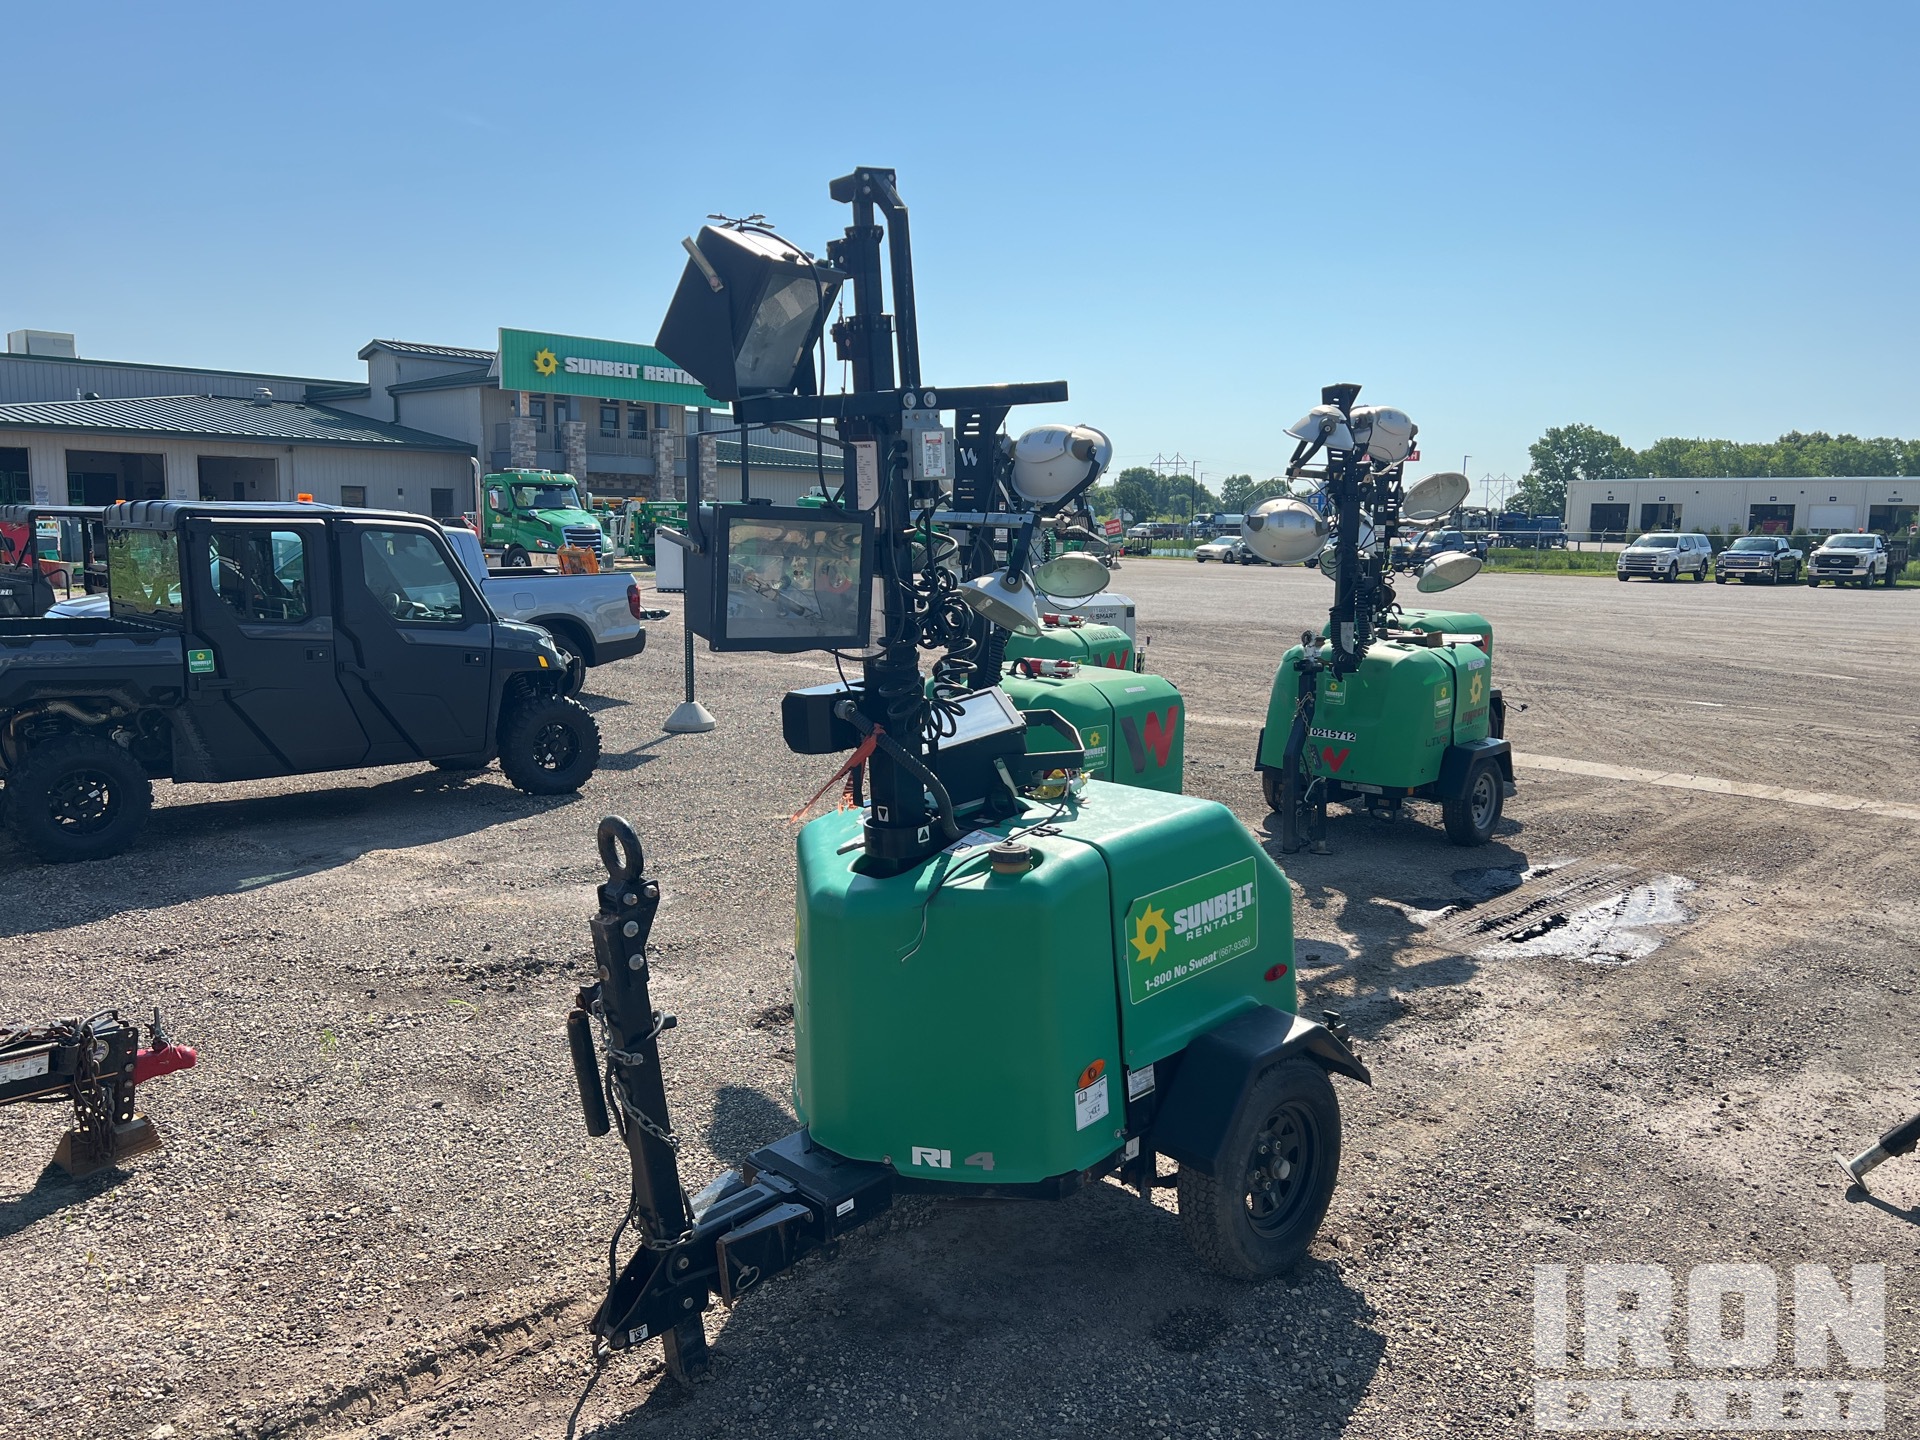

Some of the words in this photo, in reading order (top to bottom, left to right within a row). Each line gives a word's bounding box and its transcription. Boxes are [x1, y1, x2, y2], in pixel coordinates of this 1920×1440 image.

[564, 356, 640, 379] SUNBELT
[1174, 882, 1253, 935] SUNBELT
[1186, 910, 1243, 941] RENTALS
[1145, 970, 1172, 991] 1-800
[1174, 964, 1187, 979] No
[1189, 950, 1217, 972] Sweat
[964, 1151, 995, 1171] 4
